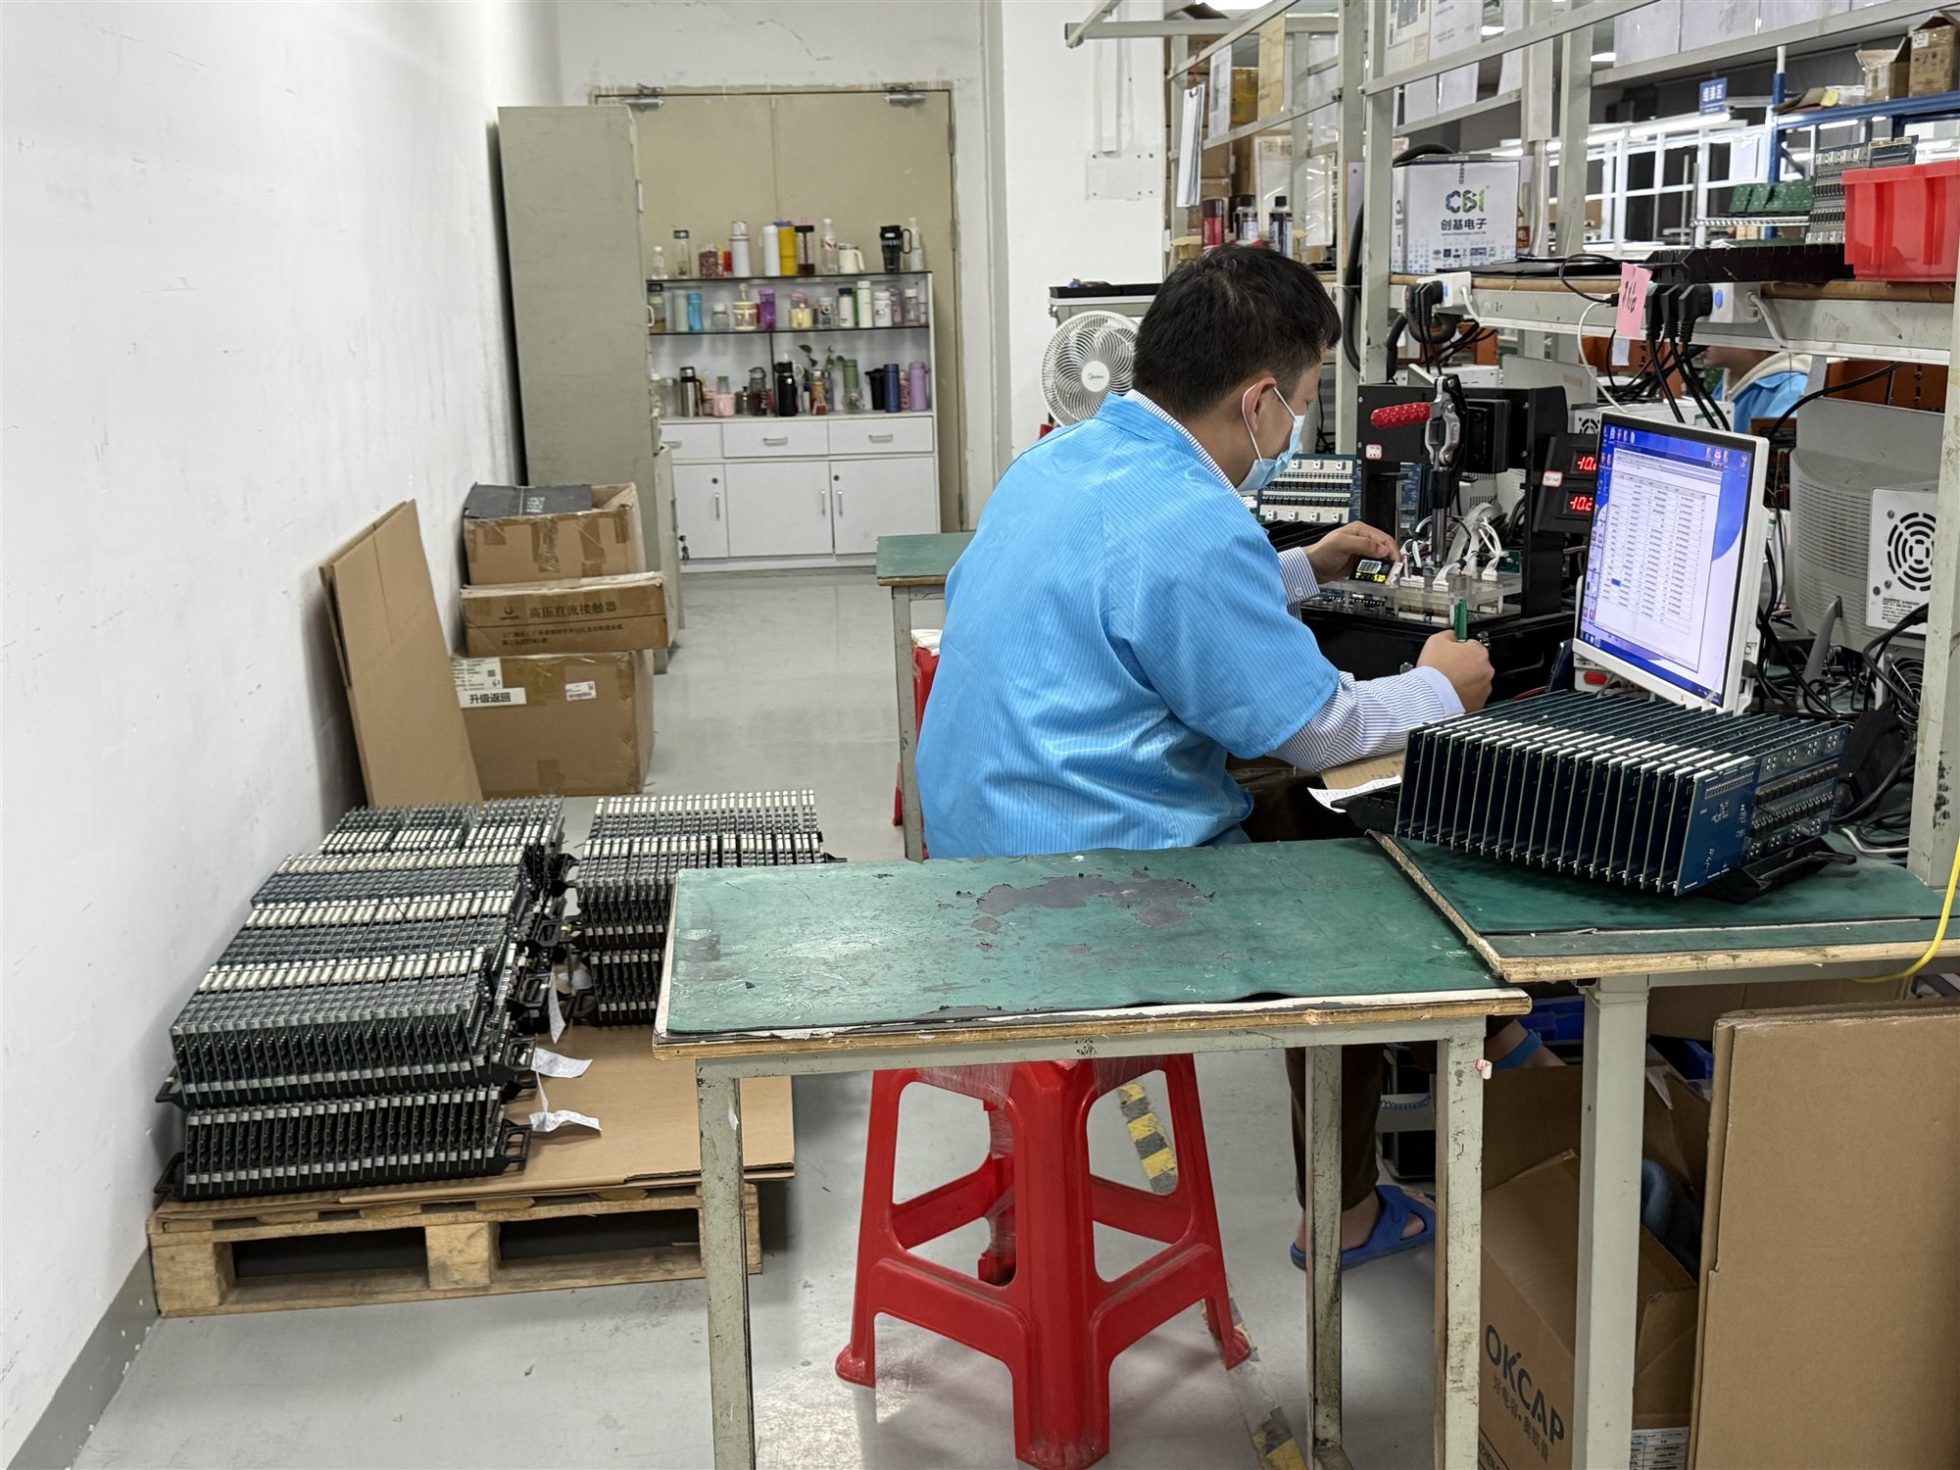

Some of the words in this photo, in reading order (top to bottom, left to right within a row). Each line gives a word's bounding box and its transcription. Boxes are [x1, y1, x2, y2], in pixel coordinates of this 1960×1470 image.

[1441, 218, 1487, 231] 创基电子
[470, 692, 511, 704] 升级返回
[1485, 1324, 1565, 1445] OKCAP
